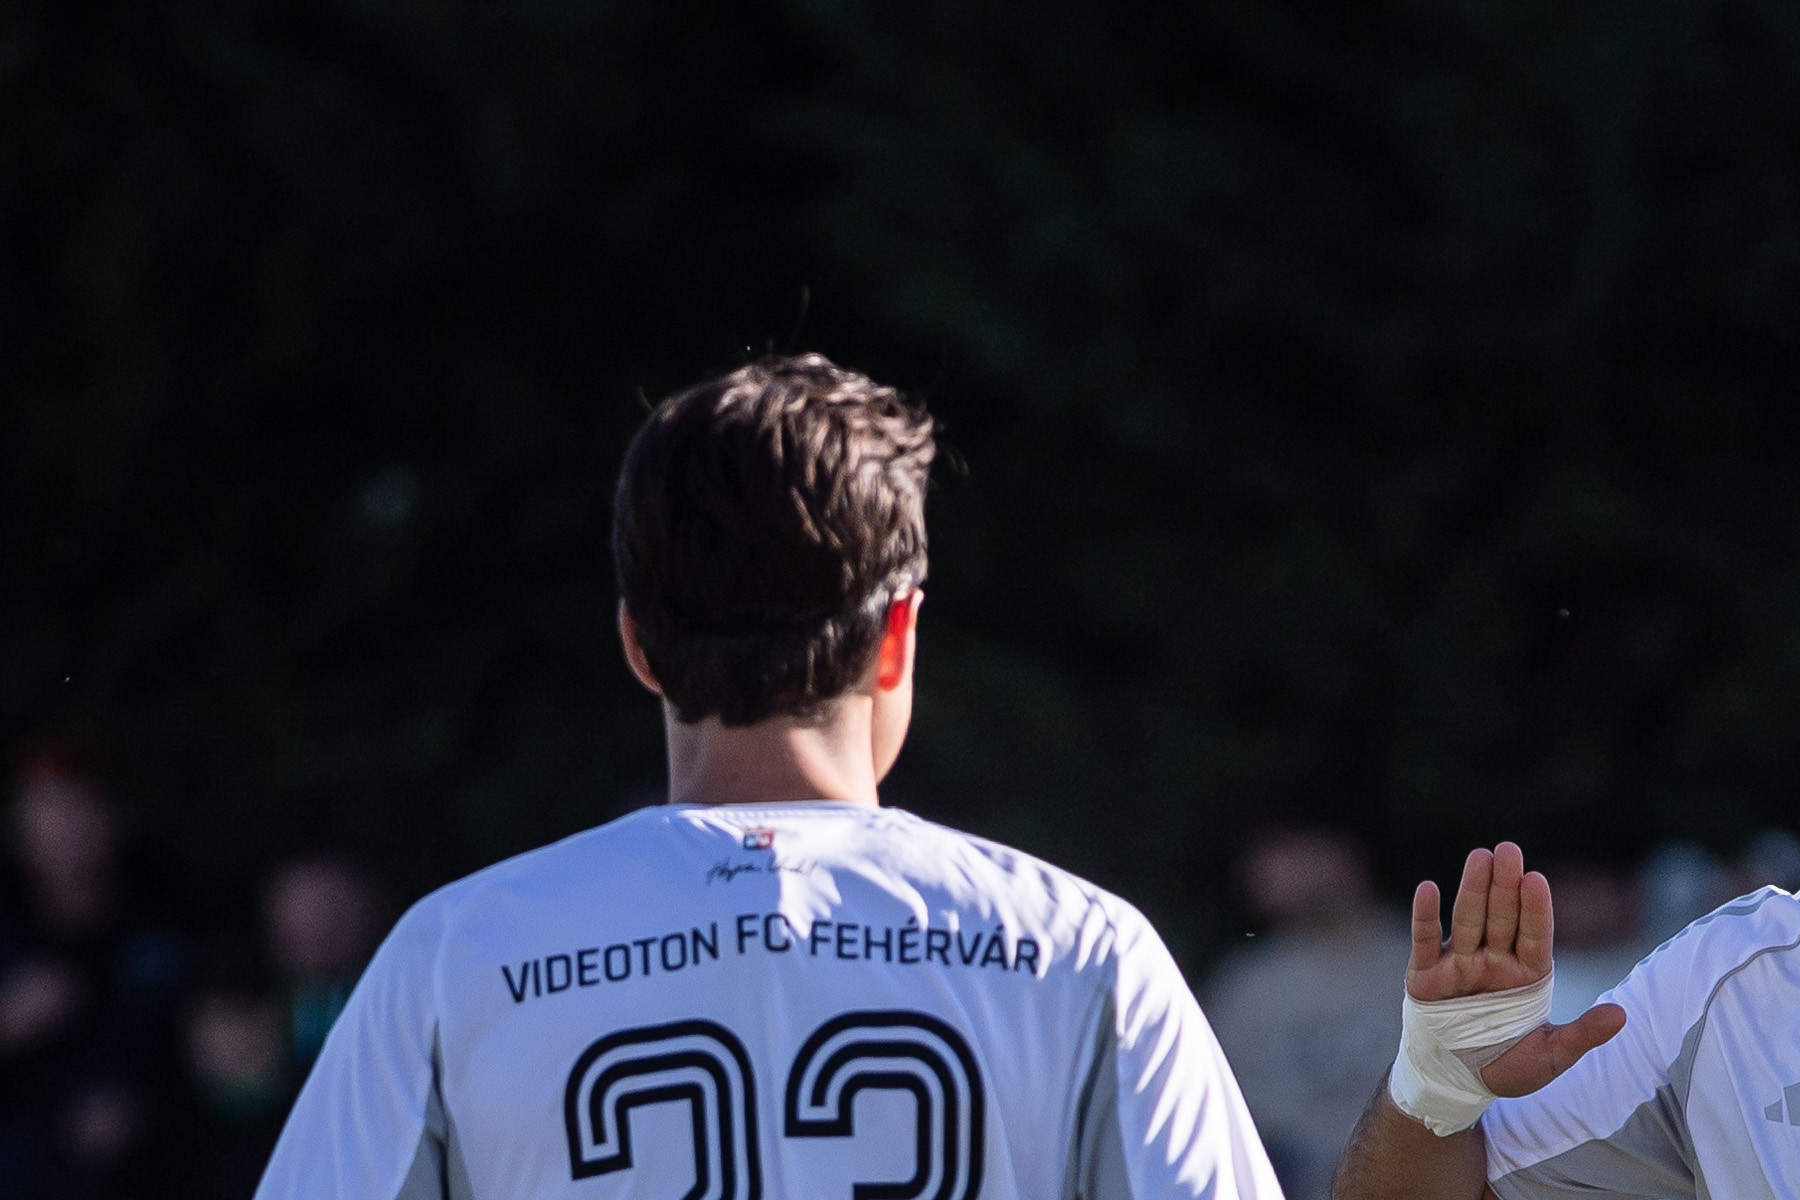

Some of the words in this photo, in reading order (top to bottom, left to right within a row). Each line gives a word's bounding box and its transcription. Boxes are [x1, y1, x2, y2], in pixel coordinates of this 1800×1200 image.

[501, 920, 719, 1004] VIDEOTON
[736, 912, 792, 955] FC
[811, 915, 1041, 977] FEHÉRVÁR
